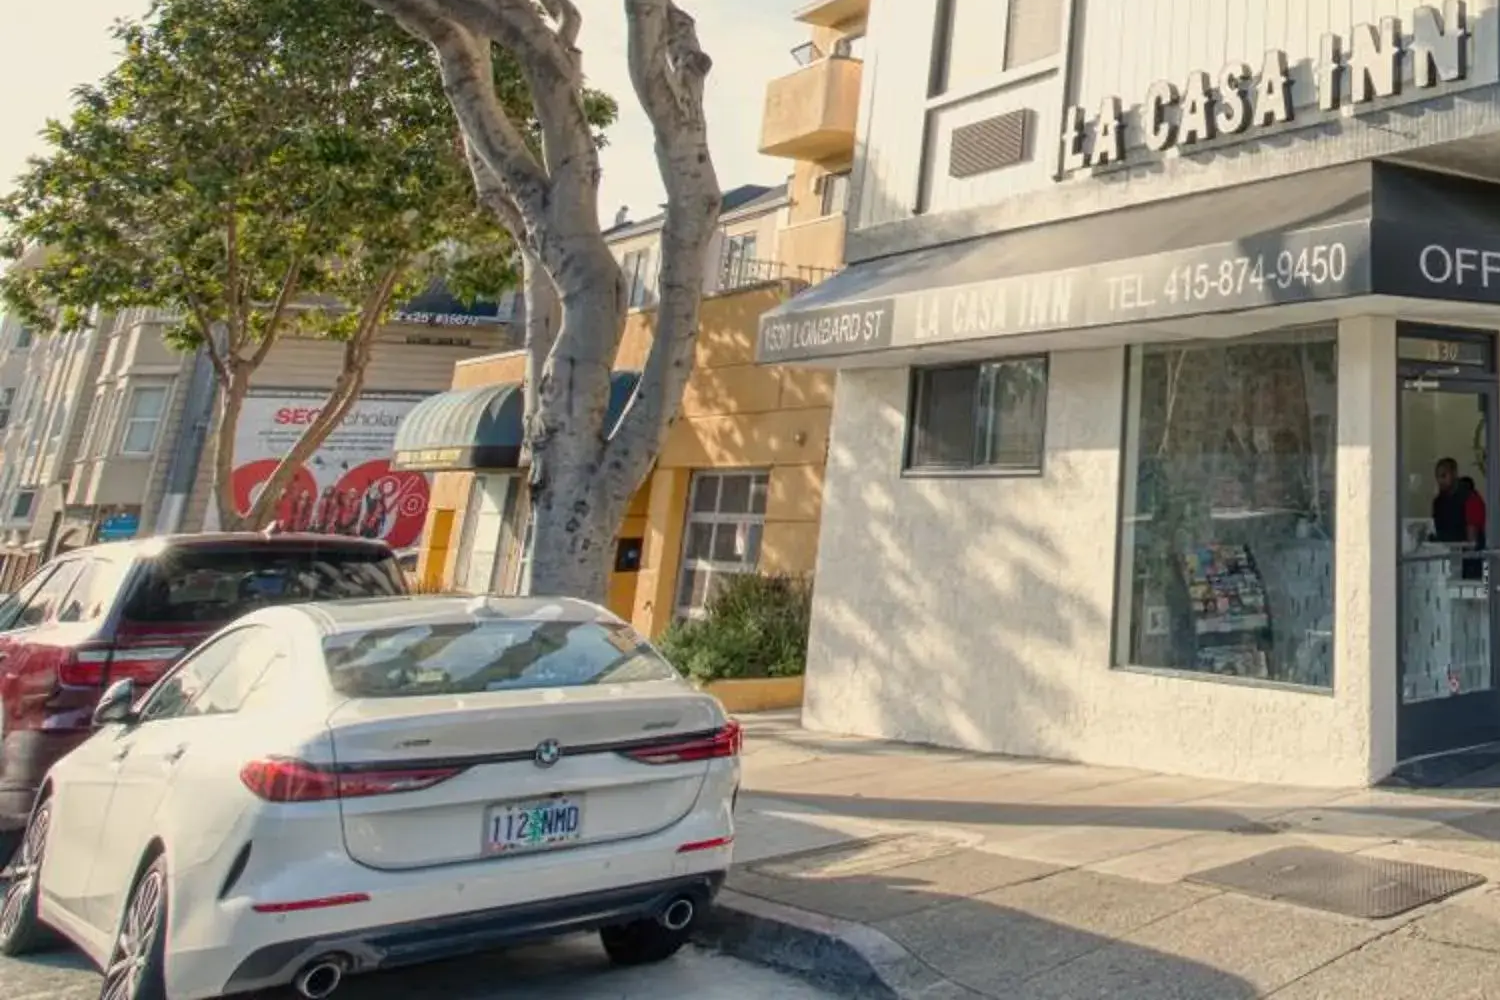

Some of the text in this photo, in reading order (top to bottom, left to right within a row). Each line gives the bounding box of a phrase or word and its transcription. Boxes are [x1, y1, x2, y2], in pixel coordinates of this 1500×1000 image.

[1063, 95, 1126, 171] LA
[1141, 48, 1296, 152] CASA
[914, 275, 1073, 339] LA CASA INN
[1106, 242, 1348, 312] TEL. 415-874-9450
[793, 311, 862, 349] LOMBARD
[863, 308, 885, 342] ST
[493, 805, 580, 843] 112 NMD
